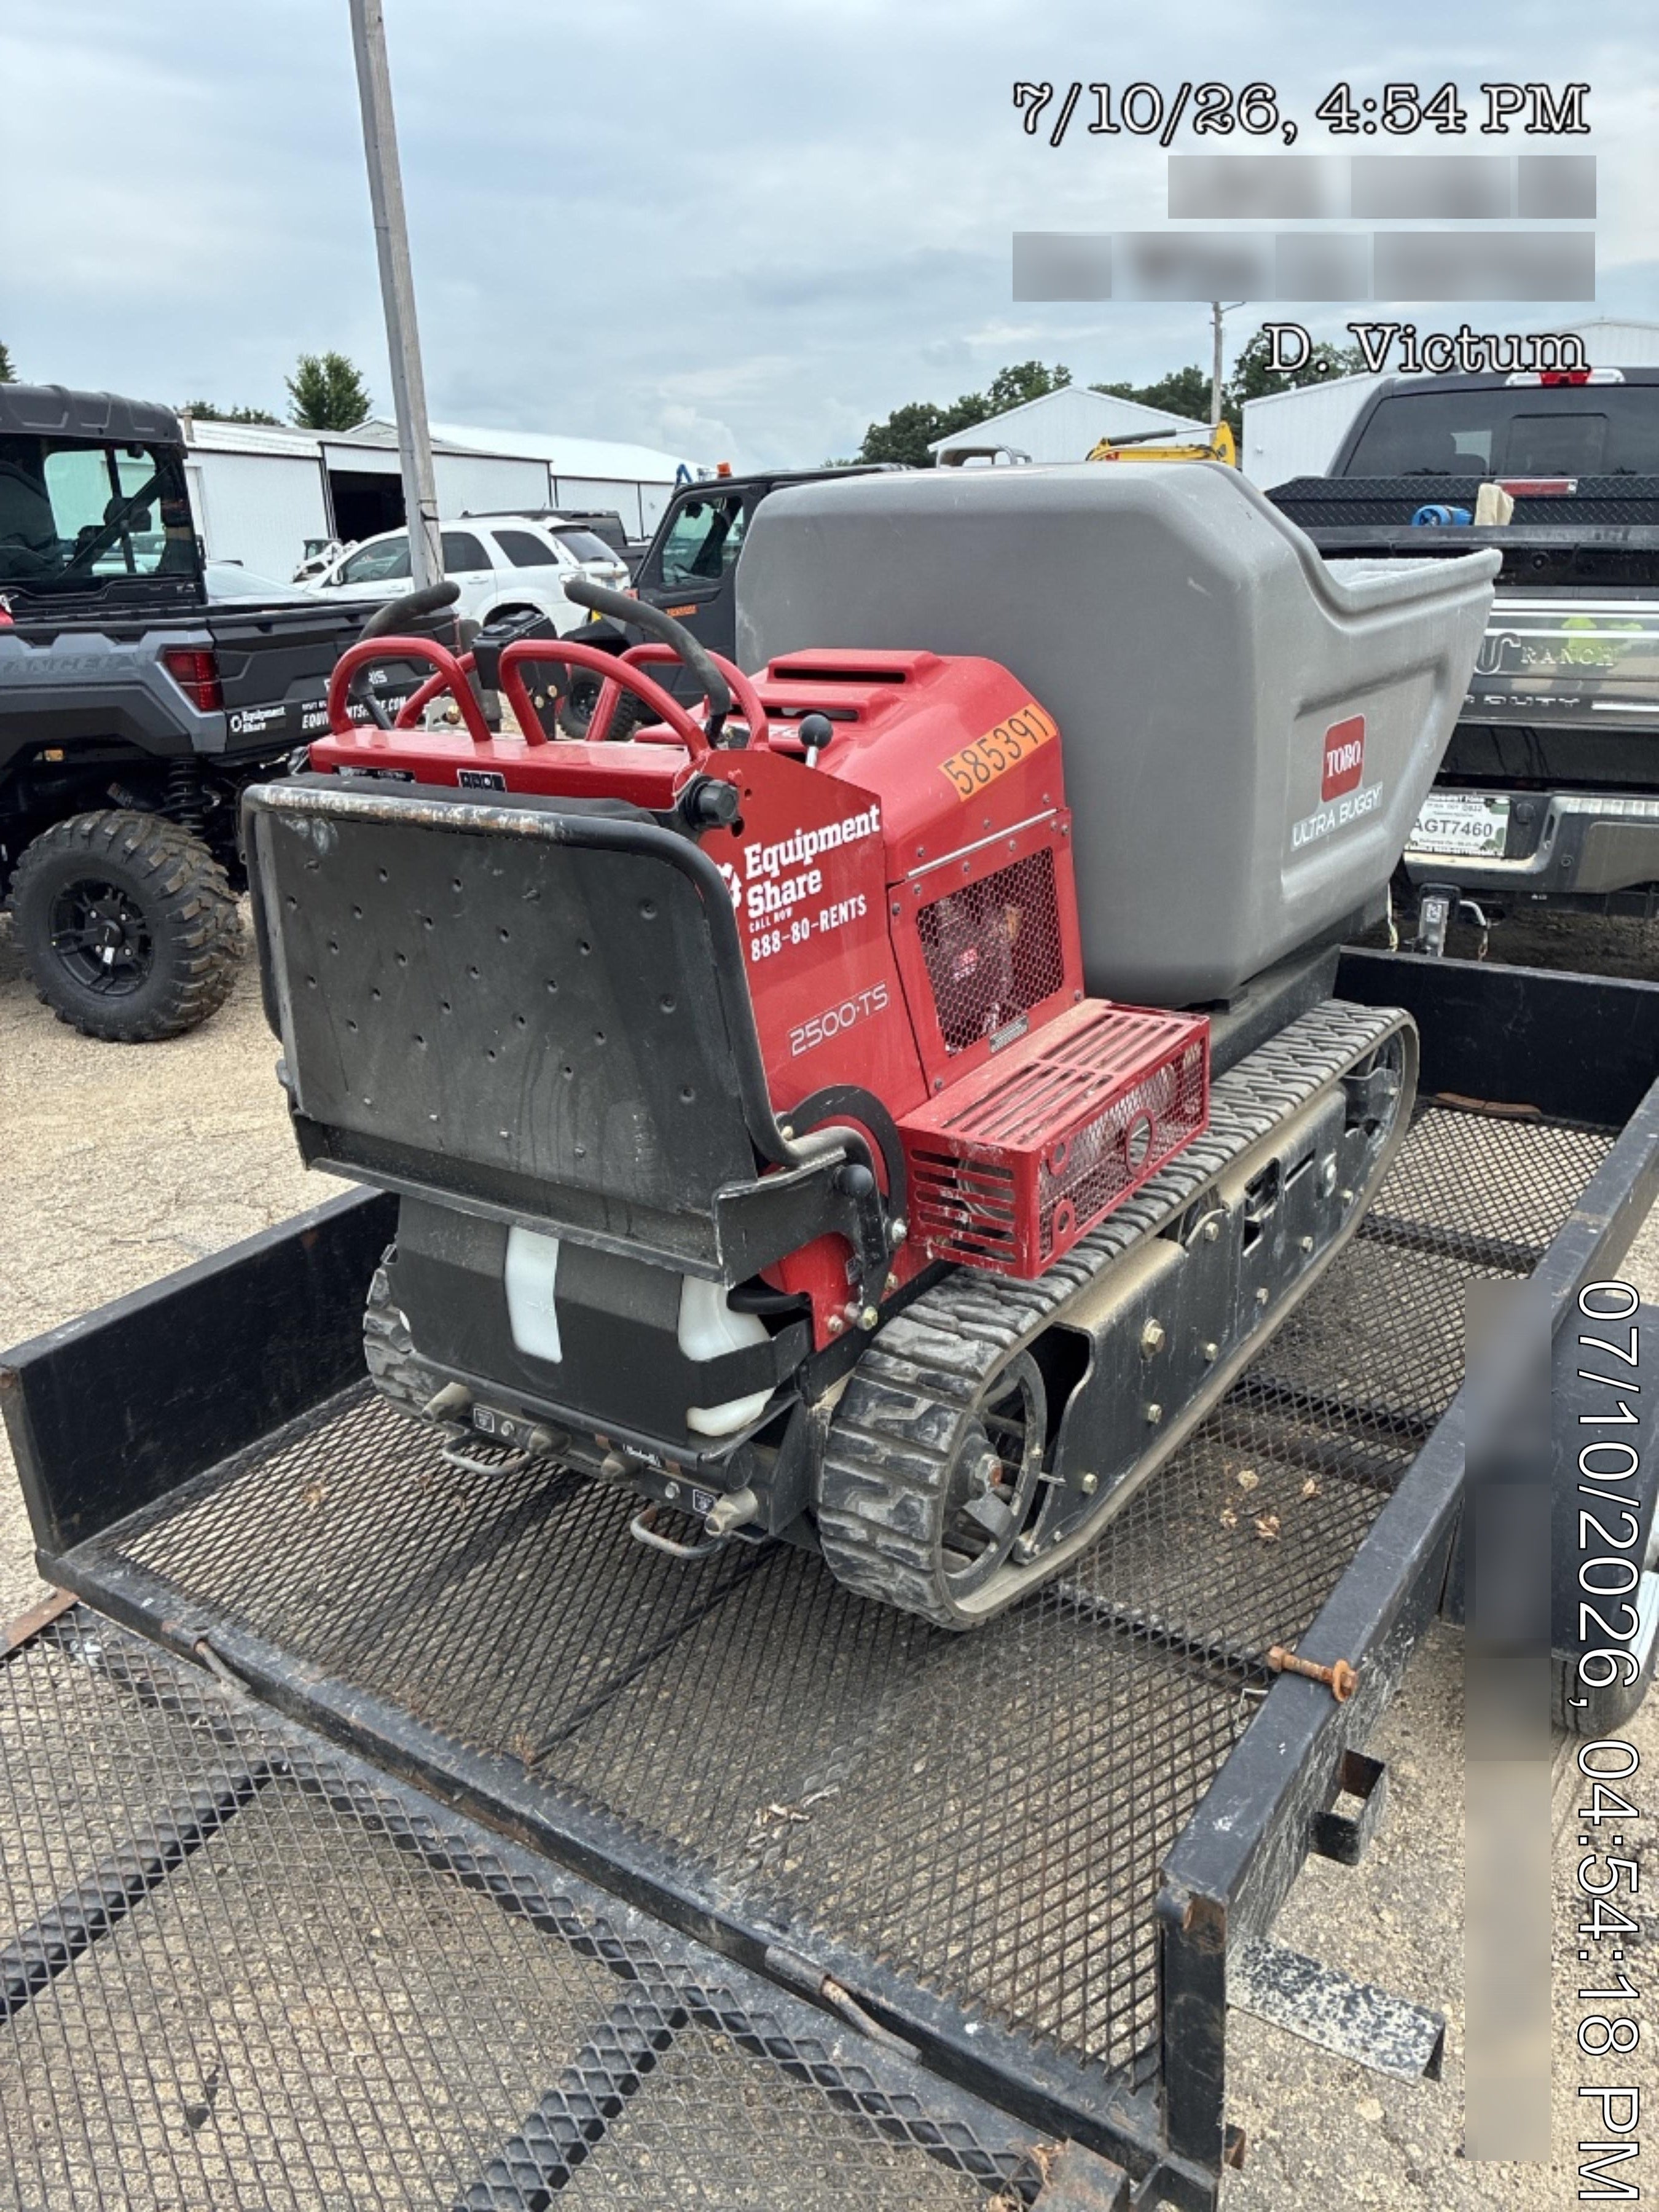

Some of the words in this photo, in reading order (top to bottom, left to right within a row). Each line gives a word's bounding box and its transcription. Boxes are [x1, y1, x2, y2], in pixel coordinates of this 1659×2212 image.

[1520, 645, 1615, 666] RANCH
[1483, 694, 1580, 707] DUTY
[943, 709, 1049, 794] 585391
[1327, 740, 1362, 779] TORO
[1293, 809, 1336, 847] ULTRA
[1339, 787, 1382, 824] BUGGY
[1413, 818, 1492, 837] AGT7460
[744, 803, 880, 879] Equipment
[747, 869, 823, 919] Share
[749, 916, 771, 933] CALL
[774, 906, 793, 924] NOW
[751, 893, 867, 962] 888-80-RENTS
